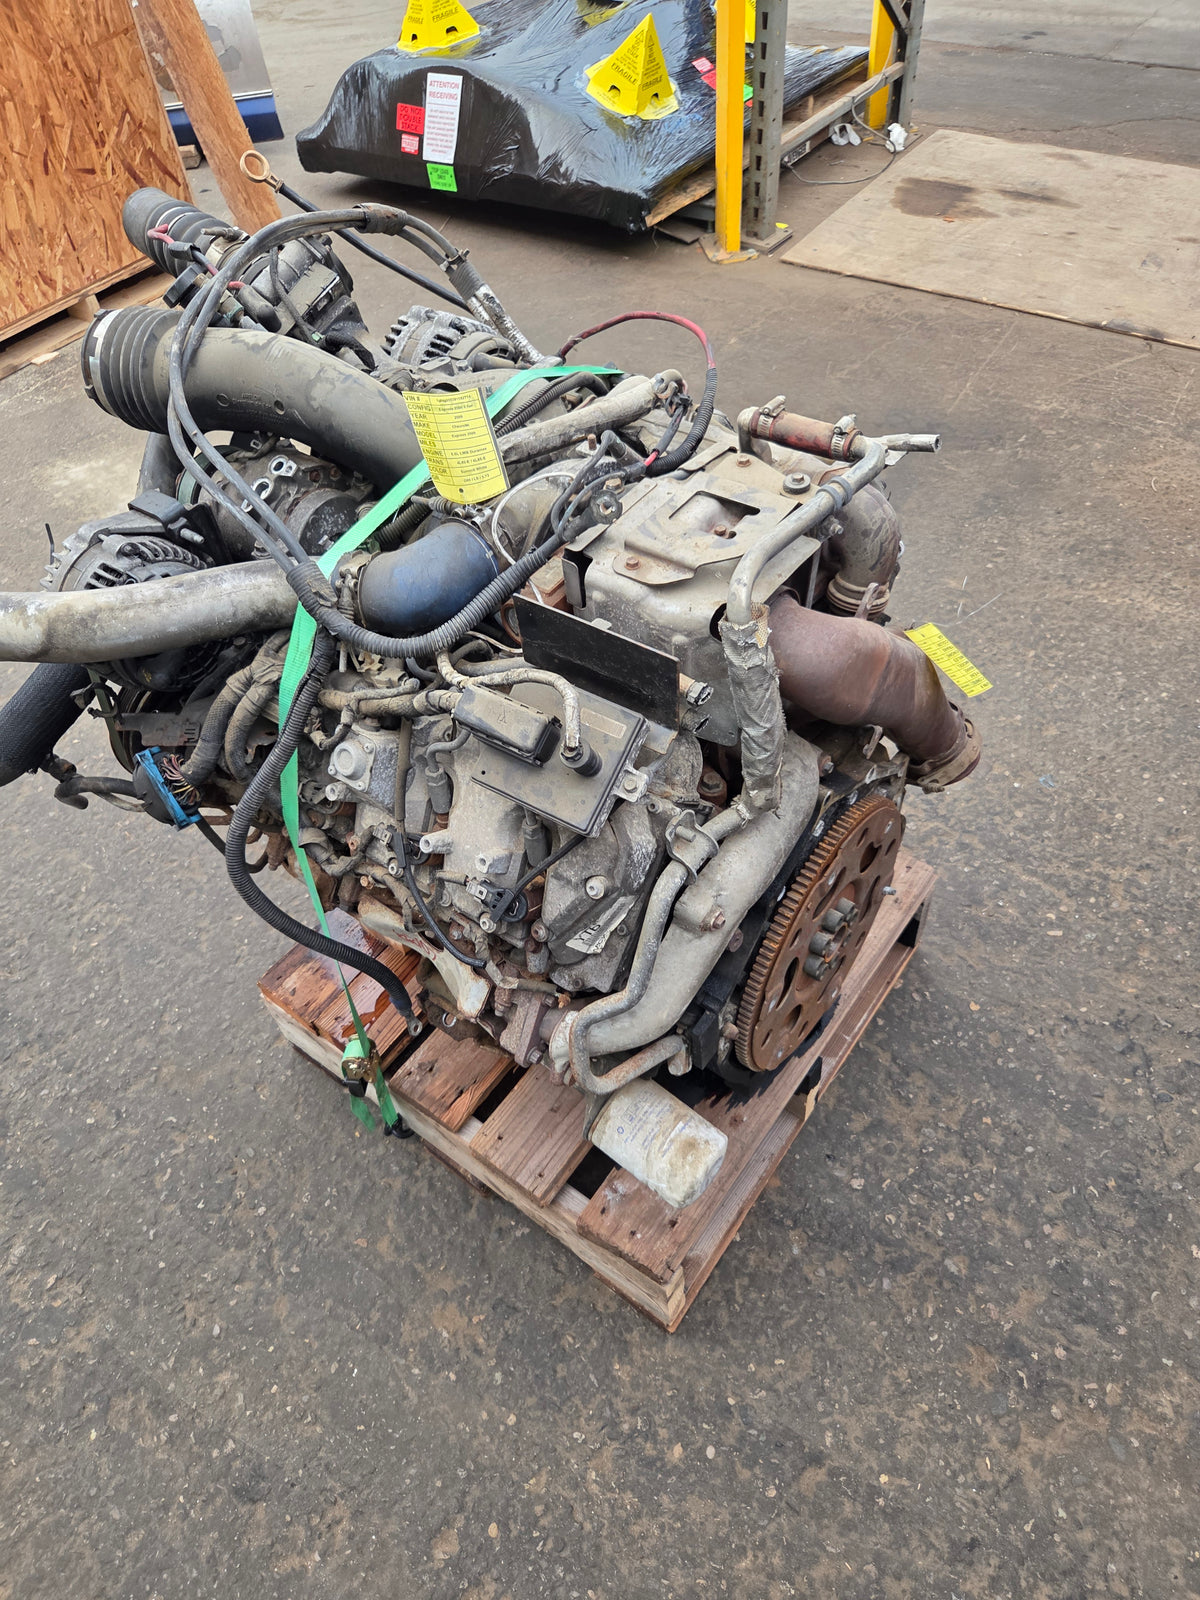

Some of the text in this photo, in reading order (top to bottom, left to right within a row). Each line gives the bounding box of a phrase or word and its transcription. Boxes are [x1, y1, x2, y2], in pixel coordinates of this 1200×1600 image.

[432, 7, 459, 23] FRAGILE
[611, 62, 638, 86] FRAGILE
[429, 80, 460, 90] ATTENTION
[428, 91, 458, 100] RECEIVING
[400, 105, 422, 116] DO NOT
[400, 114, 422, 124] DOUBLE
[401, 122, 418, 132] STACK
[416, 430, 438, 438] MODEL
[419, 440, 437, 448] MILES
[422, 449, 444, 457] ENGINE
[426, 457, 444, 465] TRANS
